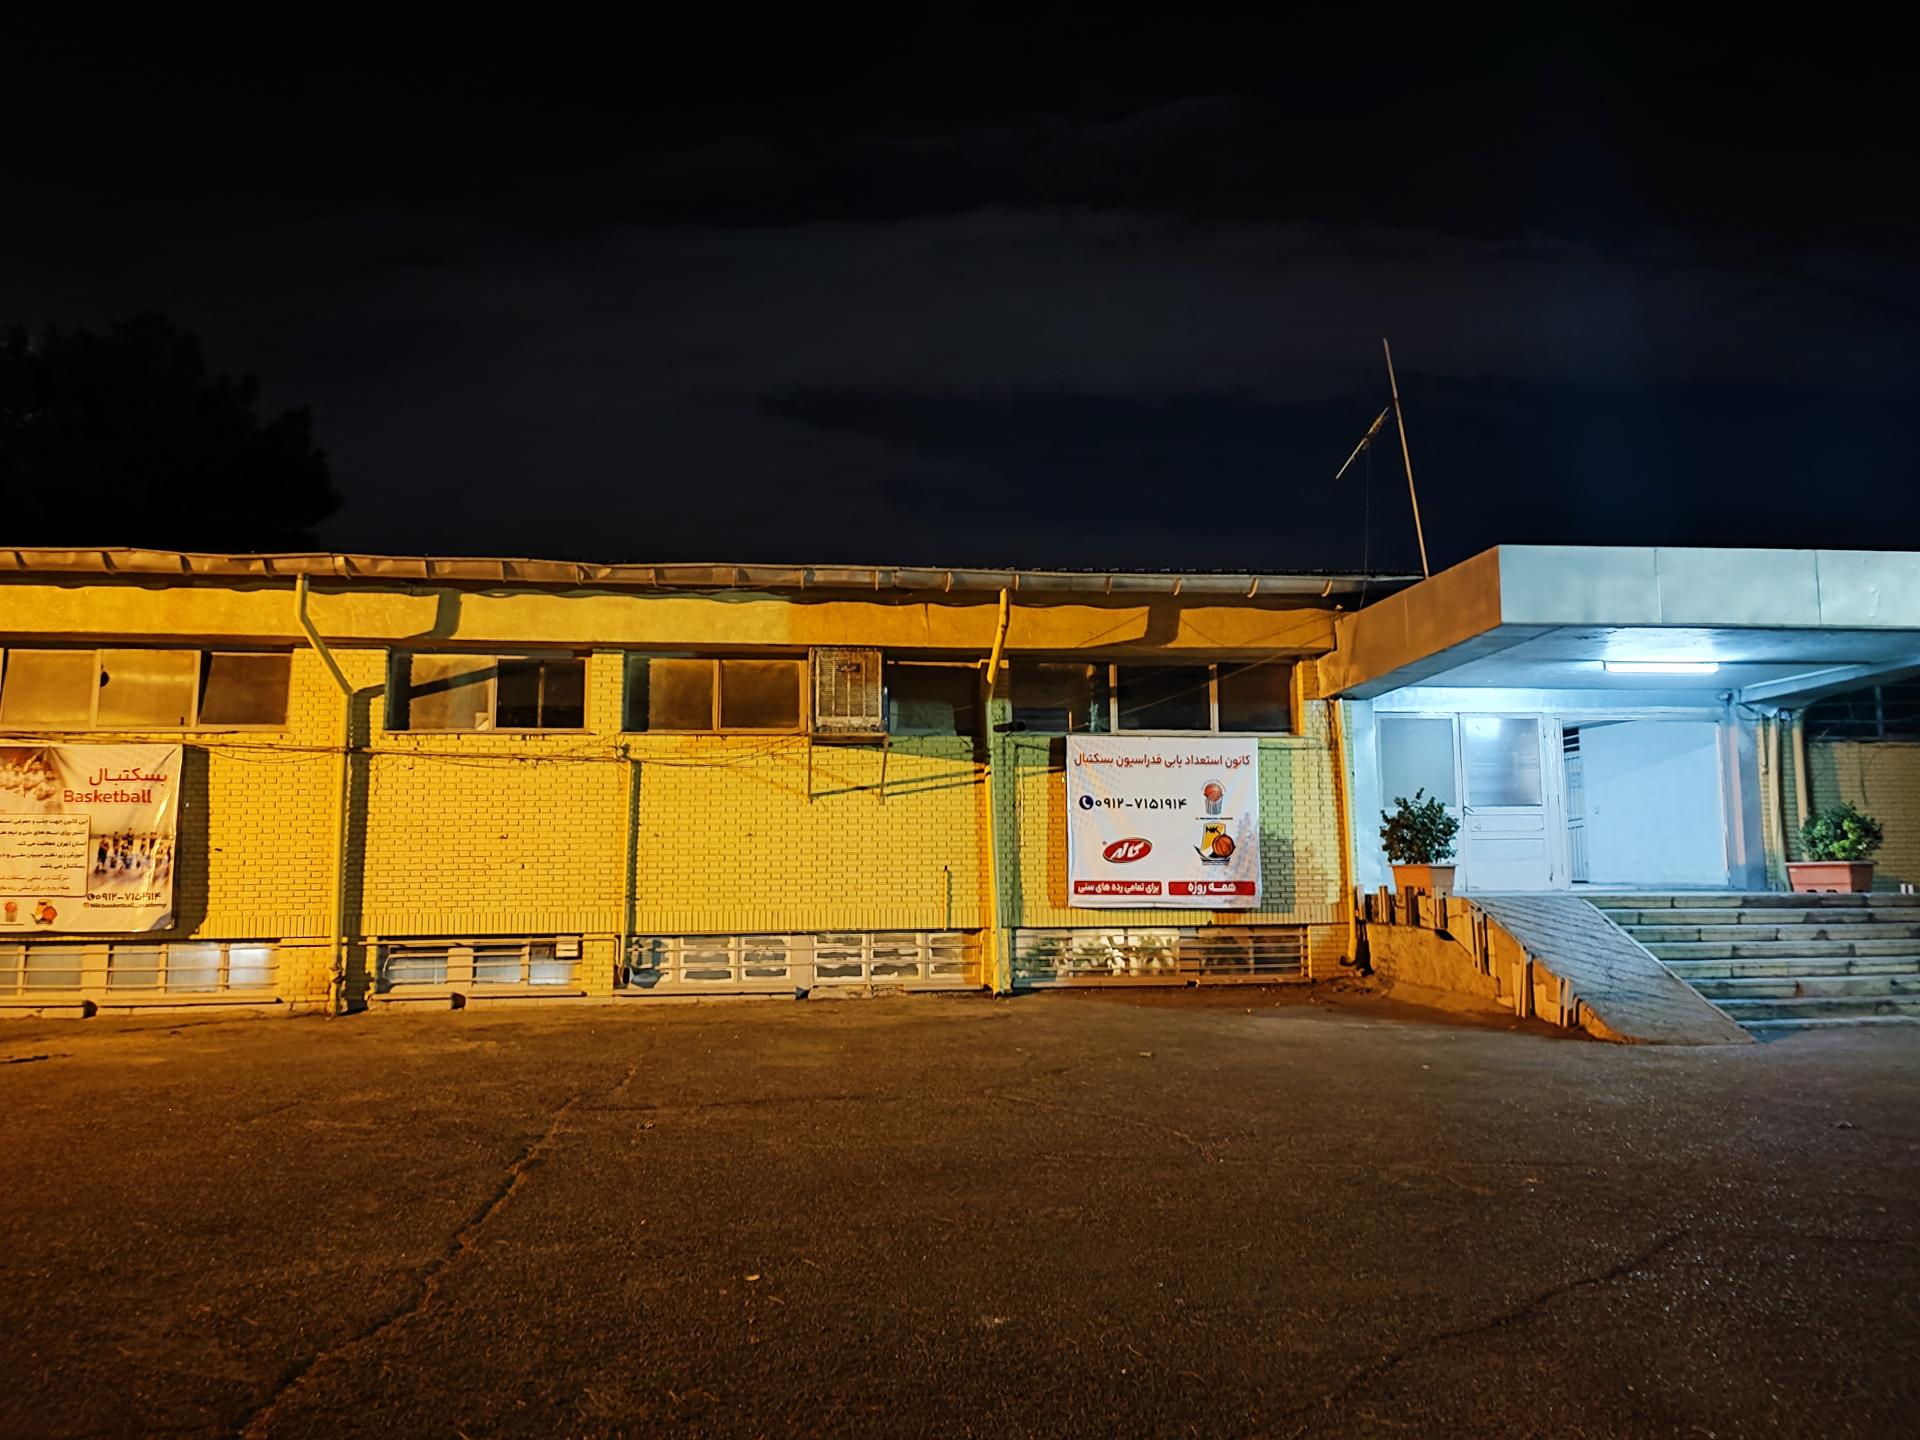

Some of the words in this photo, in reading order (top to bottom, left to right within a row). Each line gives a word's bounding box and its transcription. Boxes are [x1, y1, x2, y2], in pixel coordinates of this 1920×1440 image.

[1074, 752, 1114, 768] بسکتبال
[1116, 754, 1162, 769] فدراسیون
[1164, 754, 1183, 769] یابی
[1185, 754, 1223, 766] استعداد
[1225, 754, 1250, 769] کانون
[89, 767, 168, 787] بسکتبال
[63, 789, 152, 803] Basketball
[1077, 883, 1095, 894] سنی
[1095, 882, 1111, 894] های
[1111, 883, 1124, 894] رده
[1124, 883, 1146, 895] تمامی
[1145, 883, 1160, 894] برای
[1187, 882, 1207, 896] روزه
[1208, 883, 1237, 894] همه
